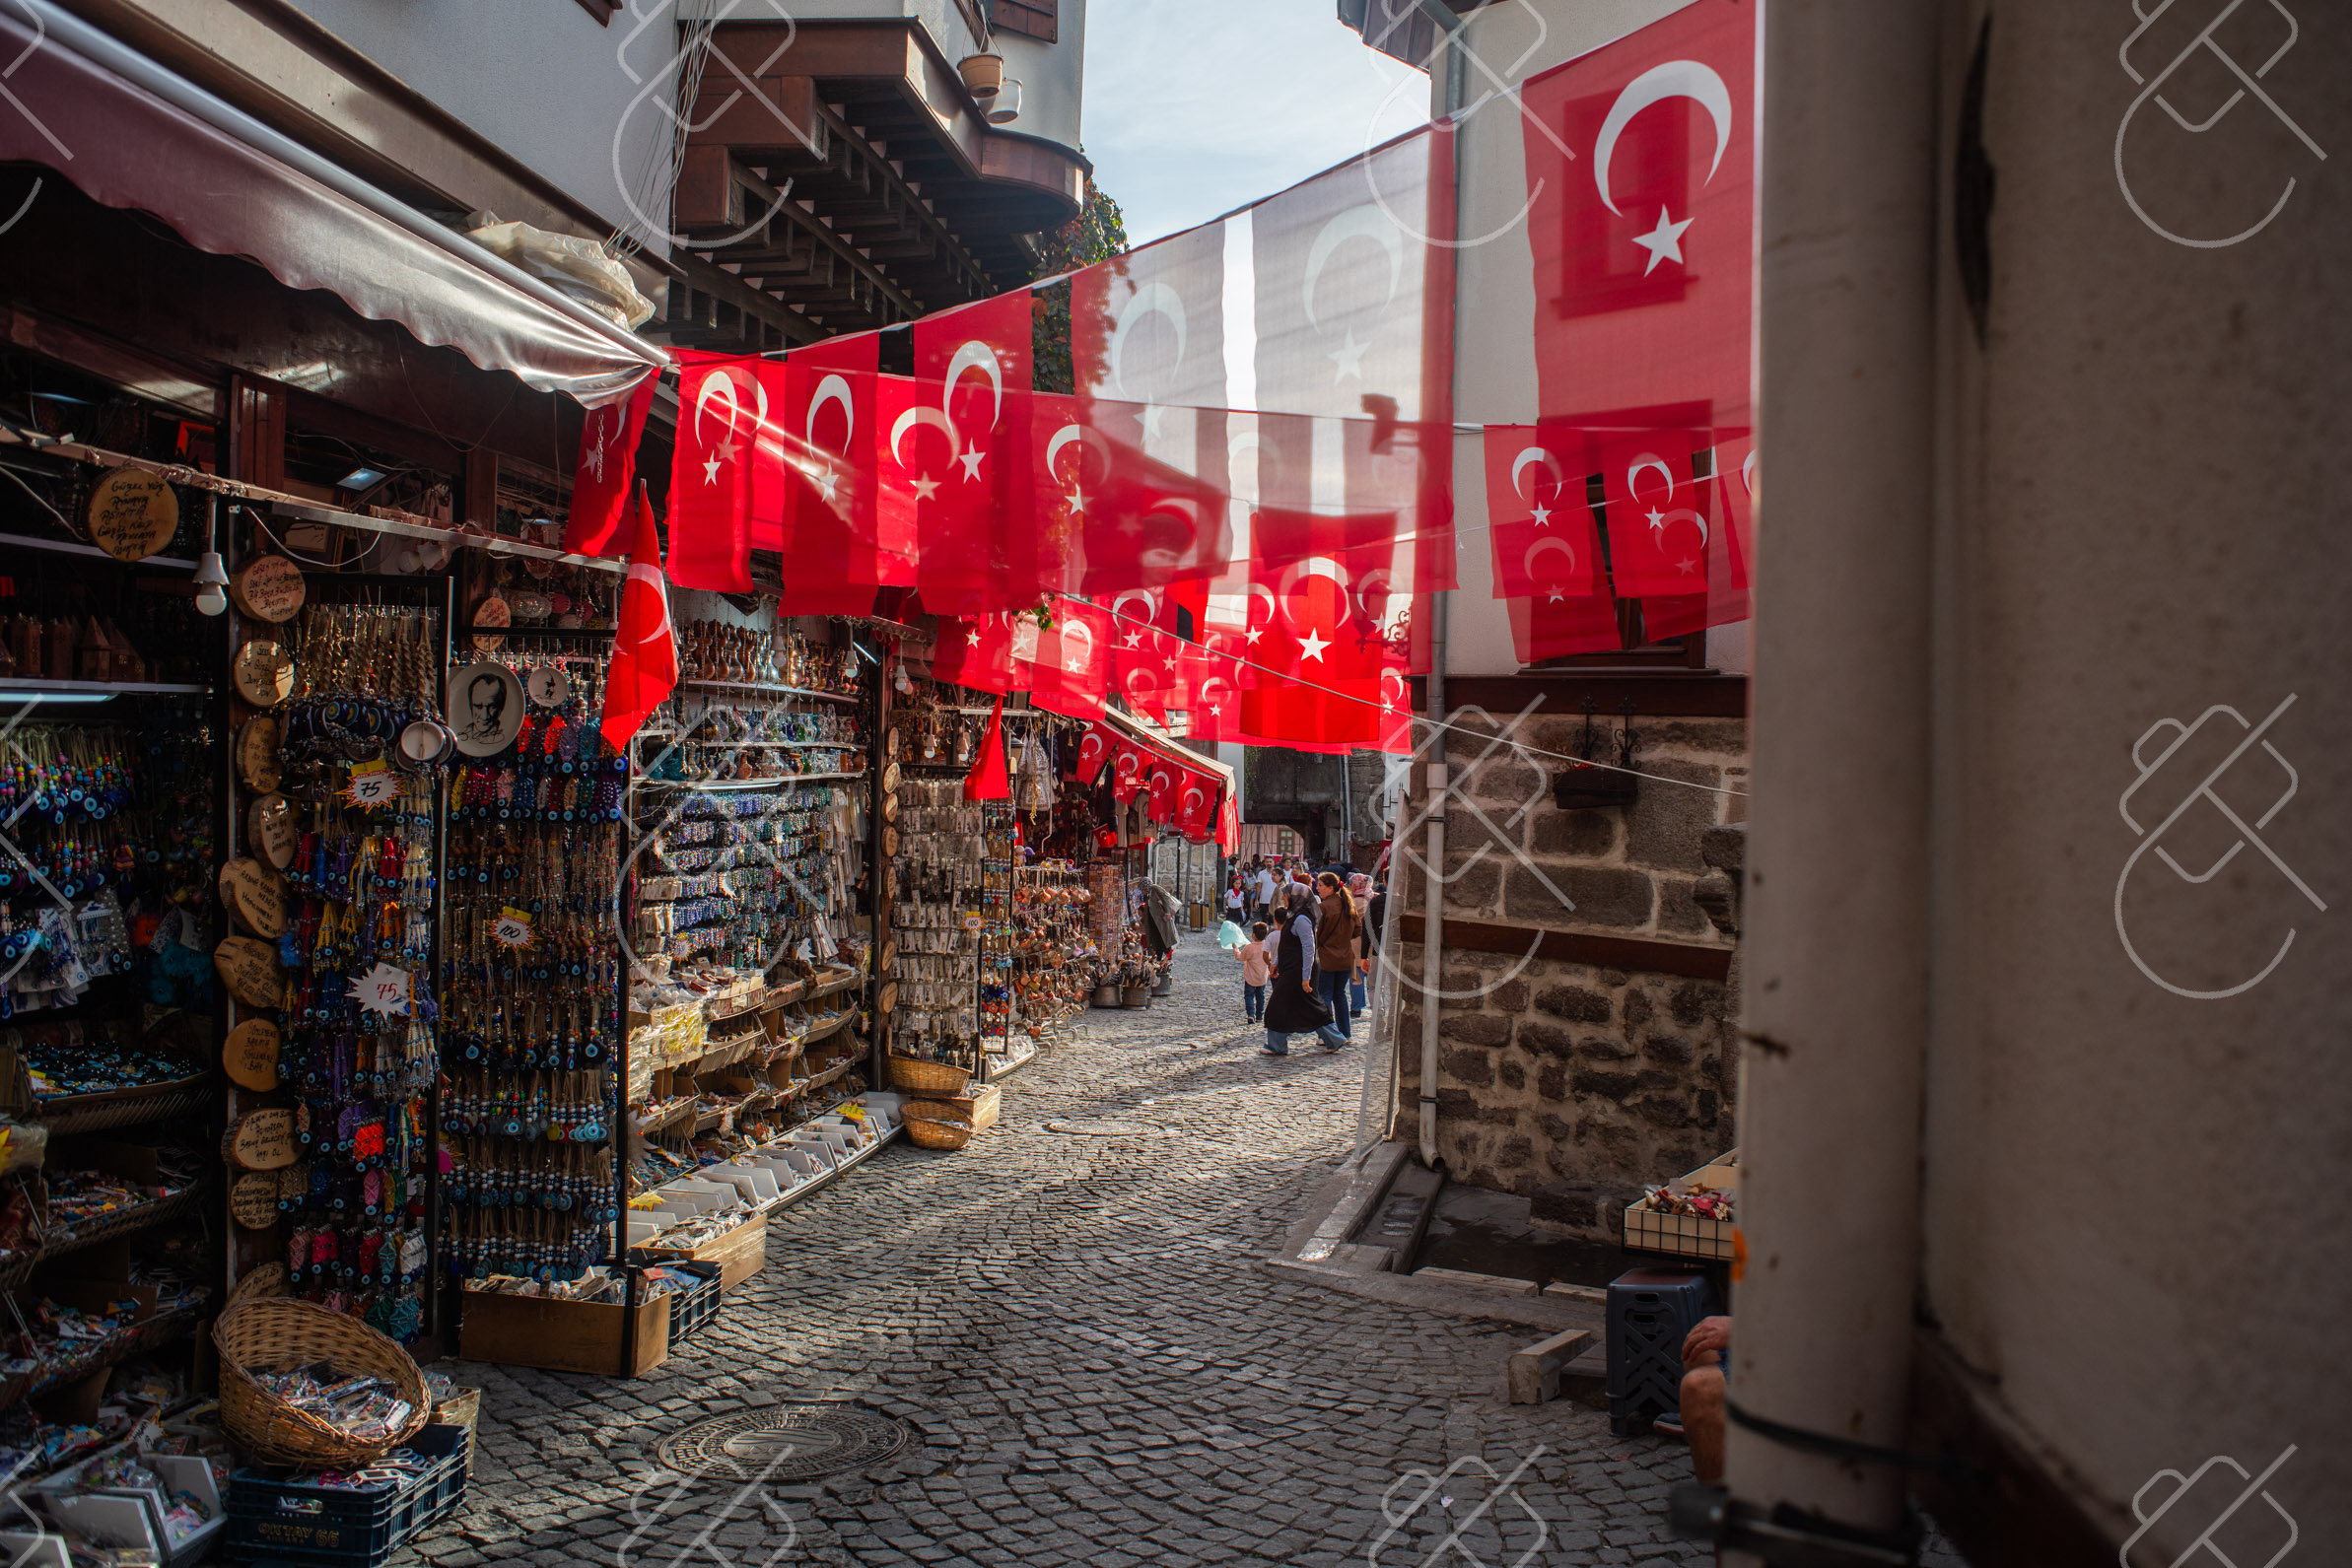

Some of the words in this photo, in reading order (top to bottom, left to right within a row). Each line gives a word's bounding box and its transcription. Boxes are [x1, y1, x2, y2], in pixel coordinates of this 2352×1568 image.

[361, 781, 383, 798] 75
[498, 924, 521, 939] 100
[377, 983, 398, 1002] 75
[258, 1522, 314, 1538] OKTAY
[315, 1529, 340, 1548] 66
